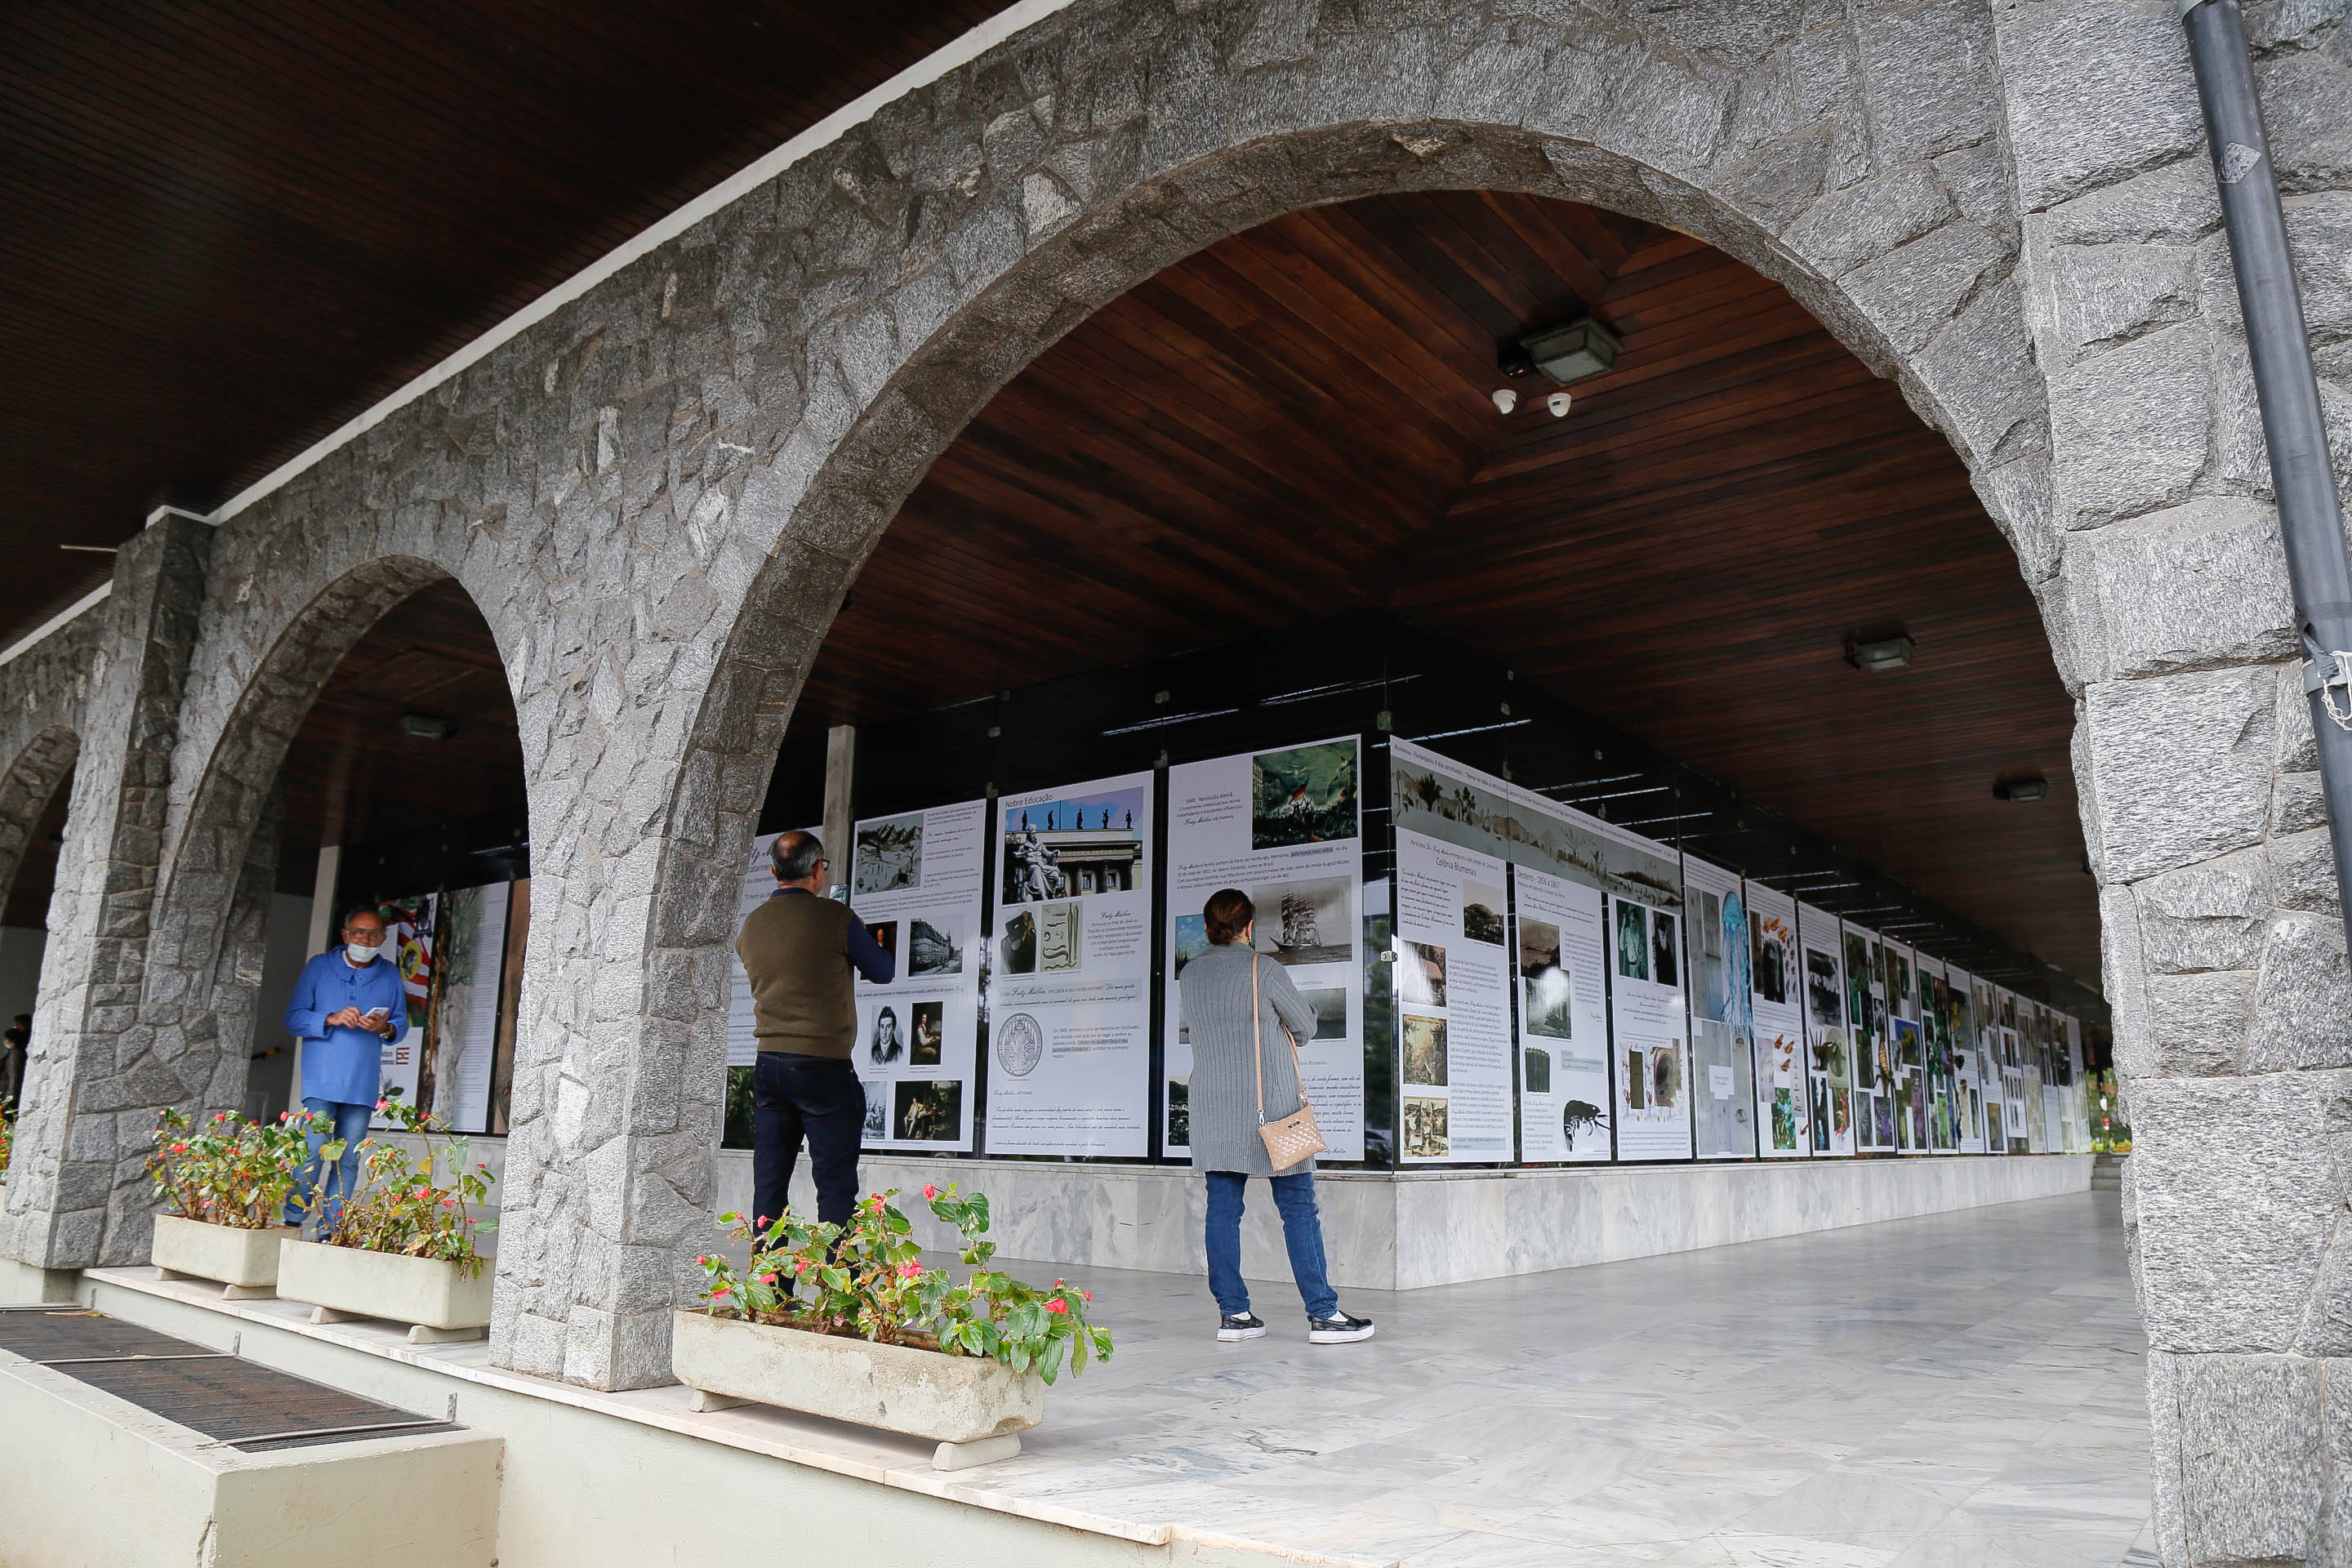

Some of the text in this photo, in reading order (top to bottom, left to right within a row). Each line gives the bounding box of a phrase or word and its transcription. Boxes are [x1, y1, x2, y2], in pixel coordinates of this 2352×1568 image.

[1006, 794, 1052, 808] Nobre Educação
[1436, 858, 1477, 876] Colônia Blumenau
[1100, 911, 1112, 920] Fritz
[1011, 987, 1026, 998] Fritz
